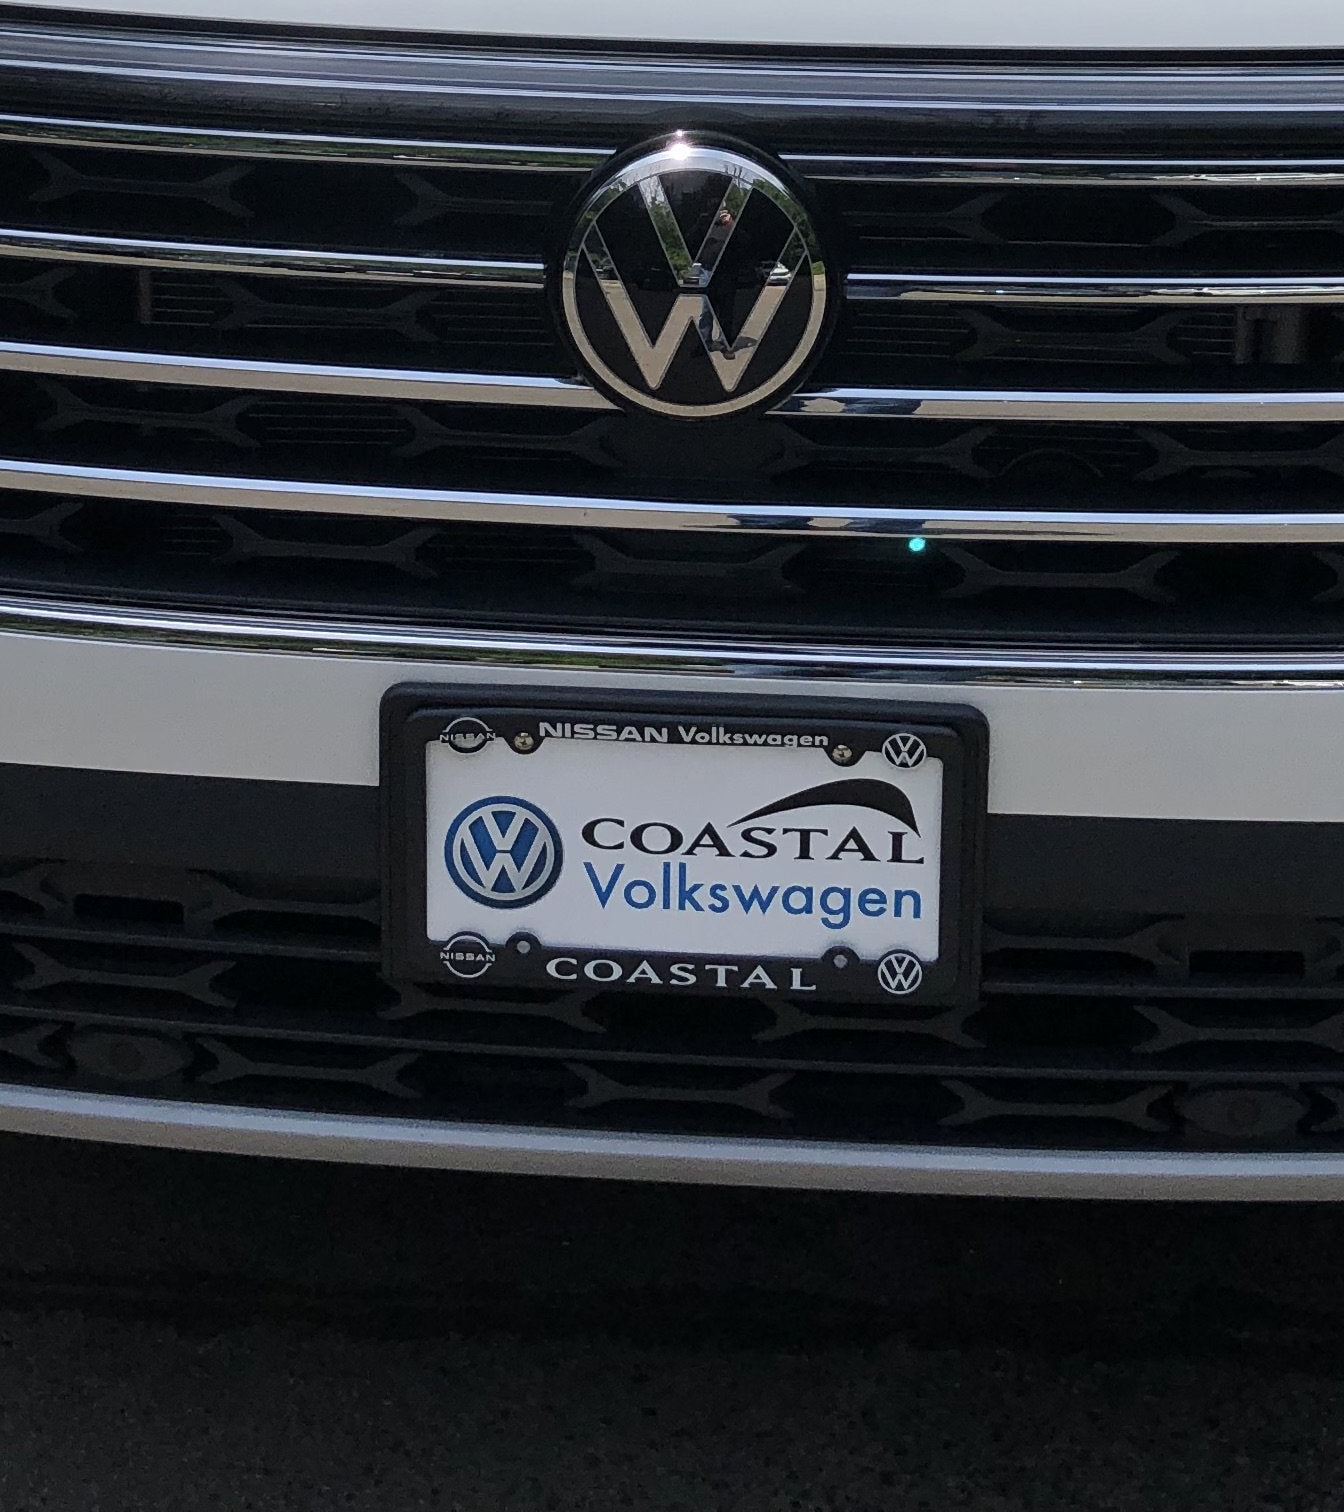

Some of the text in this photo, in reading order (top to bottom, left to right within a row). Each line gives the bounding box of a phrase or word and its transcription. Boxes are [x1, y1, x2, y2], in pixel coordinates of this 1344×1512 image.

[439, 732, 496, 742] NISSAN
[539, 722, 829, 748] NISSAN Volkswagen
[581, 817, 924, 865] COASTAL
[583, 861, 921, 930] Volkswagen
[439, 952, 496, 962] NISSAN
[546, 957, 816, 991] COASTAL
